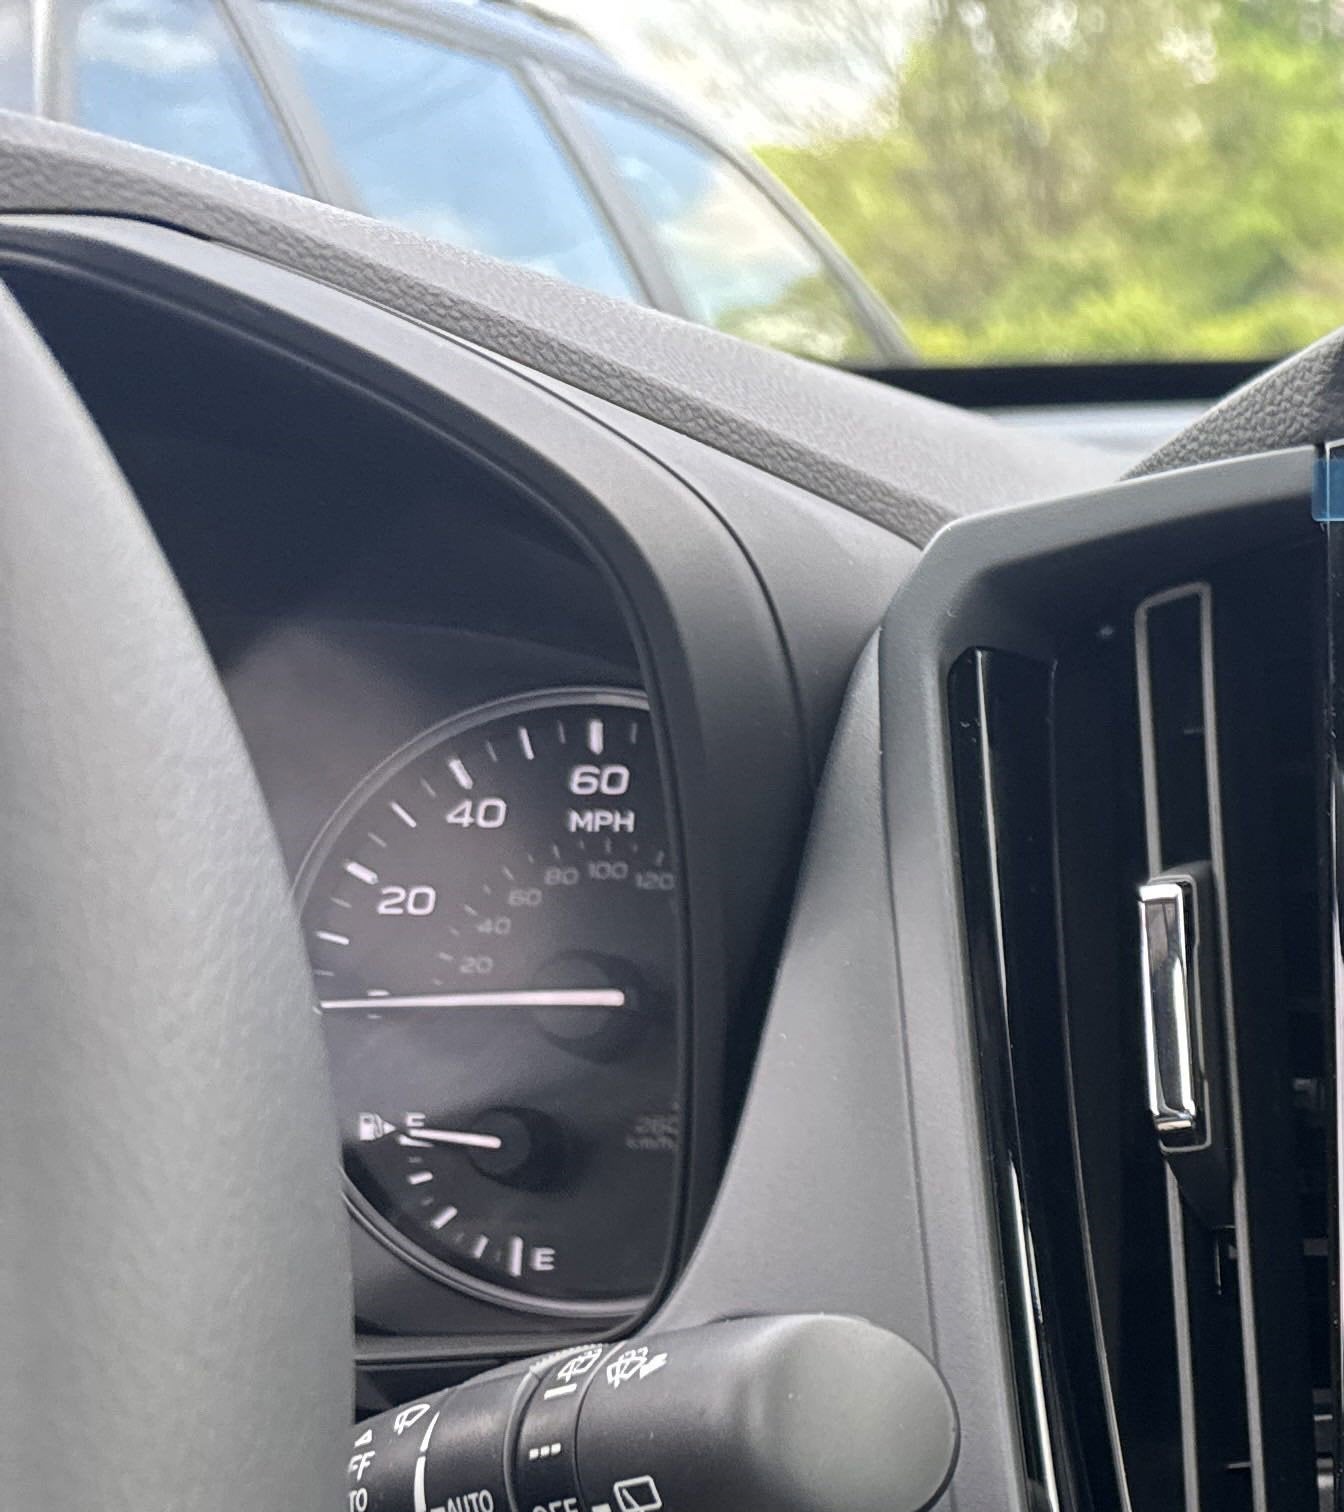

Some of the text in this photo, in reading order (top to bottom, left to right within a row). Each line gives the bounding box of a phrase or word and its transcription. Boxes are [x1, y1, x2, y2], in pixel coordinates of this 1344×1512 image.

[570, 765, 630, 795] 60
[446, 798, 507, 829] 40
[569, 810, 636, 834] MPH
[588, 860, 629, 881] 100
[377, 887, 436, 917] 20
[530, 1247, 556, 1270] E
[348, 1450, 376, 1481] FF
